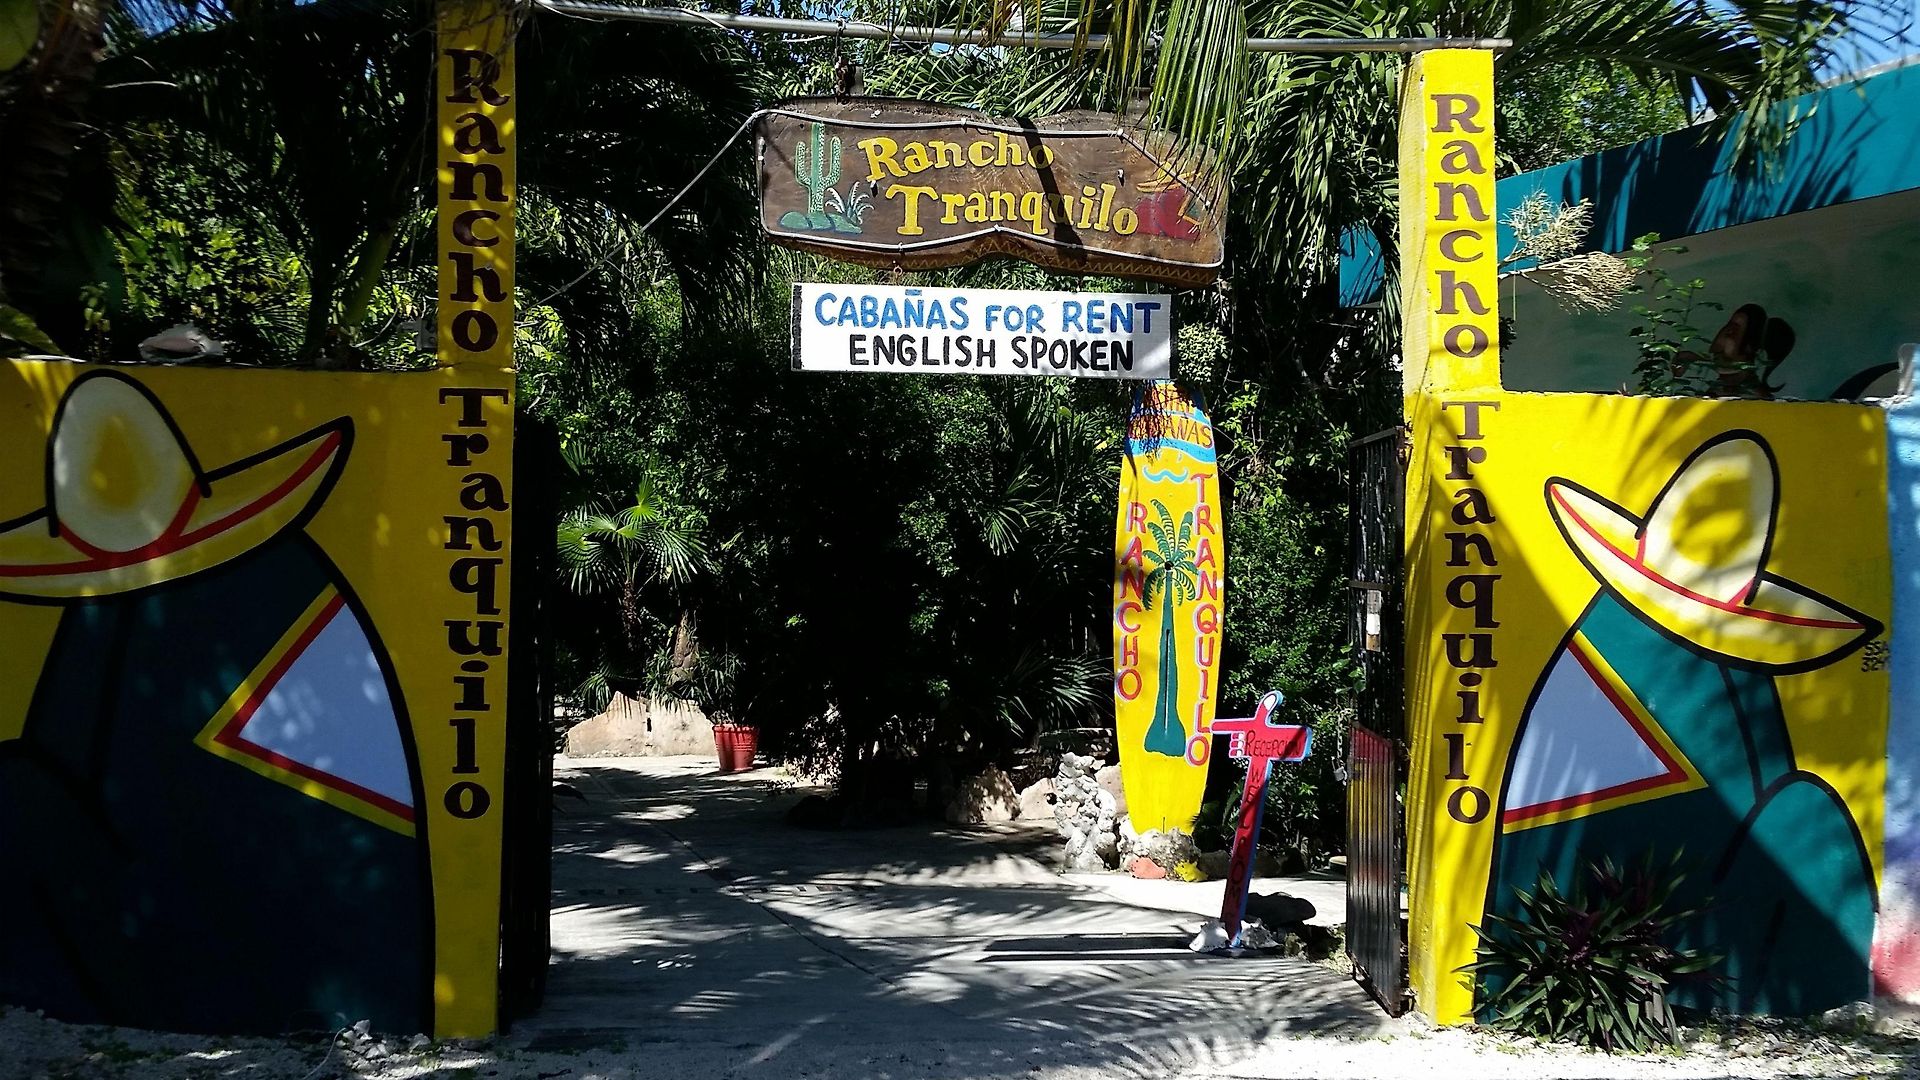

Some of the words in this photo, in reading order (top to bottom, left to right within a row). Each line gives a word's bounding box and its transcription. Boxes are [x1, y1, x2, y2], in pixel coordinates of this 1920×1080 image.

[443, 48, 510, 352] Rancho
[858, 132, 1054, 182] Rancho
[885, 183, 1139, 235] Tranquilo
[1430, 93, 1490, 358] Rancho
[815, 288, 969, 329] CABAÑAS
[985, 304, 1044, 334] FOR
[1062, 300, 1161, 334] RENT
[850, 334, 996, 368] ENGLISH
[1011, 335, 1134, 371] SPOKEN
[439, 387, 510, 819] Tranquilo
[1115, 502, 1147, 700] RANCHO
[1186, 473, 1218, 766] TRANQUILO
[1442, 401, 1502, 824] Tranquilo
